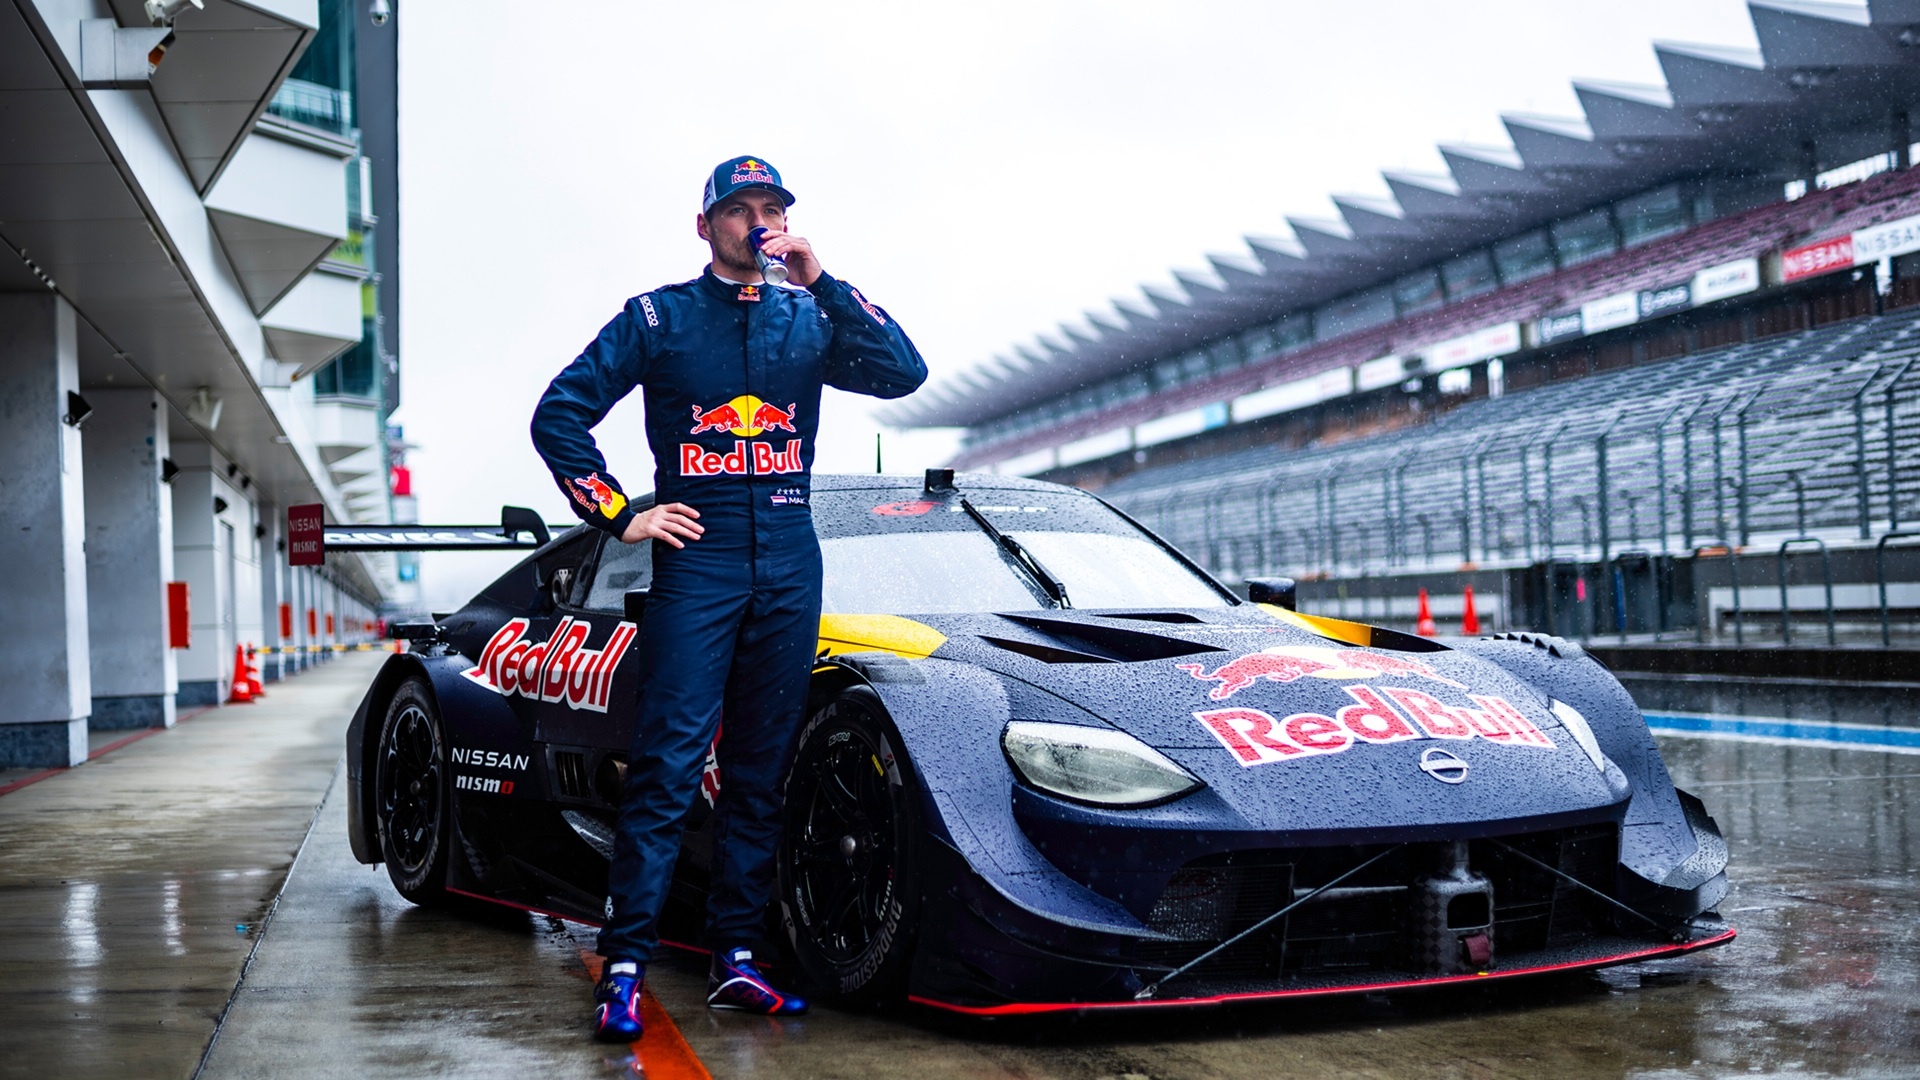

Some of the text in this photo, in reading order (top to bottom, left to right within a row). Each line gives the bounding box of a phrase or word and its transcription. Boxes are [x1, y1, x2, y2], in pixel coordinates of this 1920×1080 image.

[731, 171, 774, 184] Red Bull
[1784, 239, 1853, 275] NISSAN
[680, 439, 803, 476] Red Bull
[289, 517, 321, 531] NISSAN
[459, 615, 637, 713] Red Bull
[1191, 684, 1559, 767] Red Bull
[451, 748, 529, 770] NISSAN
[456, 775, 514, 794] nismo
